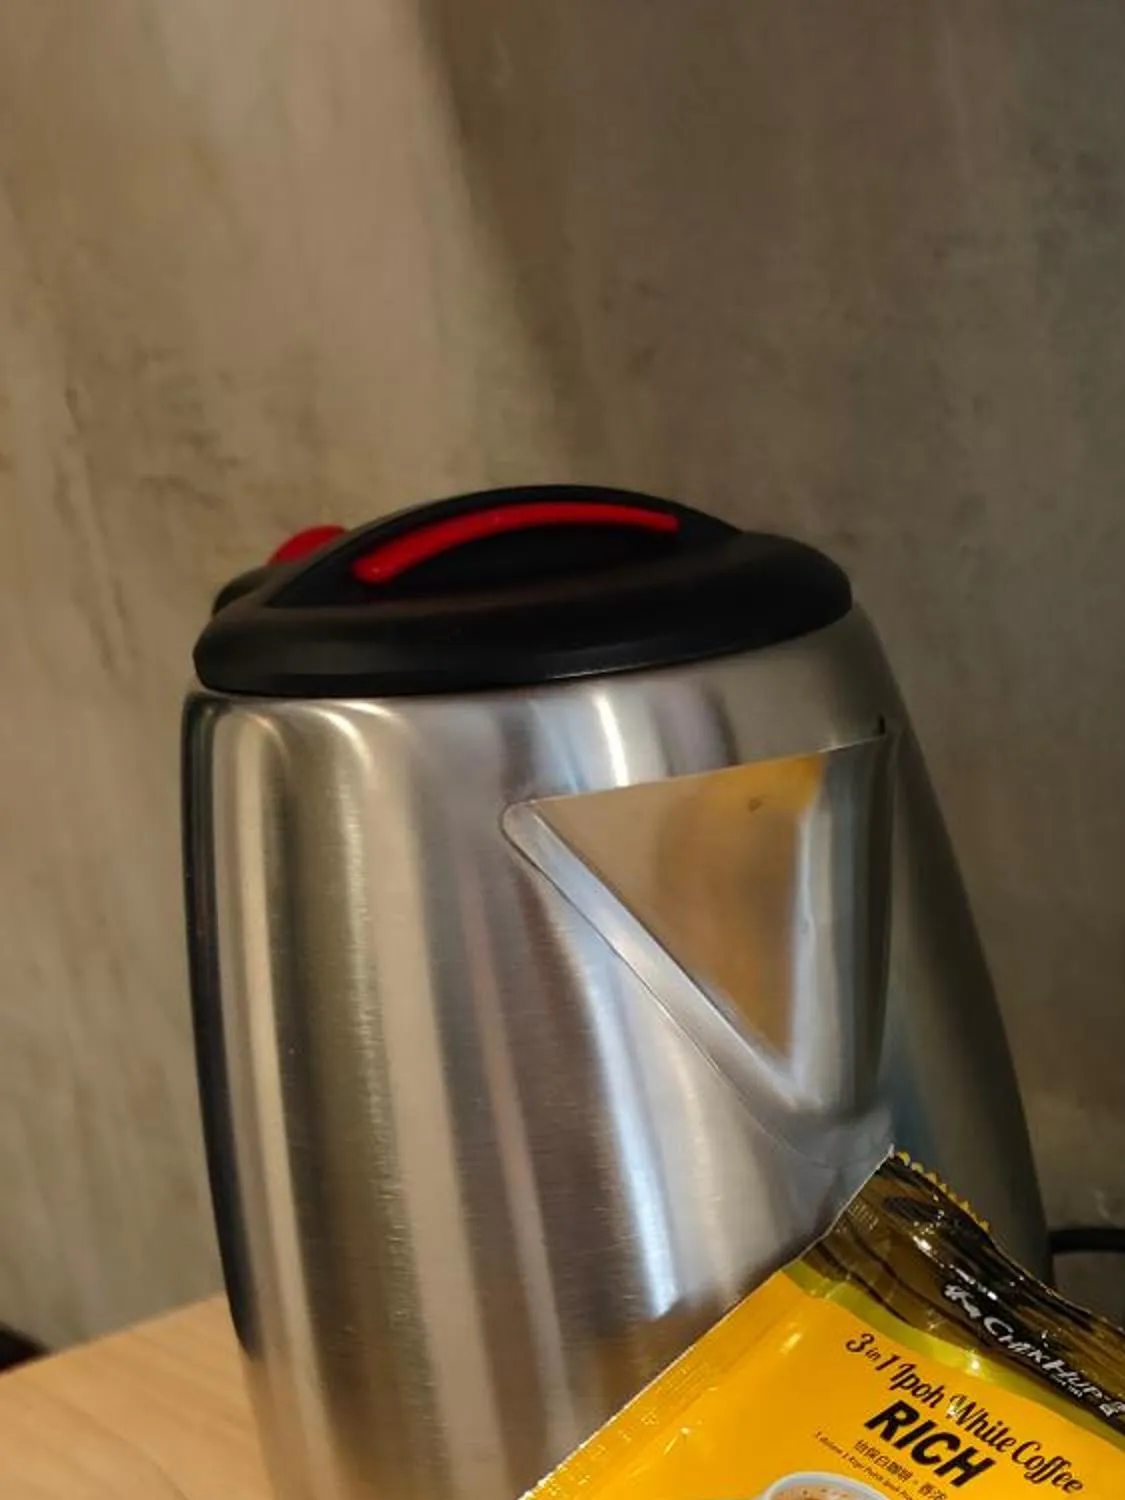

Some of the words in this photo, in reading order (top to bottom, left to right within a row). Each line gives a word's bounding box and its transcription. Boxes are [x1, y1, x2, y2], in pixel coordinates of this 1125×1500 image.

[846, 1333, 875, 1353] 3
[864, 1346, 882, 1362] in
[876, 1353, 900, 1372] 1
[889, 1361, 946, 1409] Ipoh
[946, 1394, 1018, 1454] White
[1011, 1440, 1085, 1494] Coffee
[863, 1399, 997, 1488] RICH
